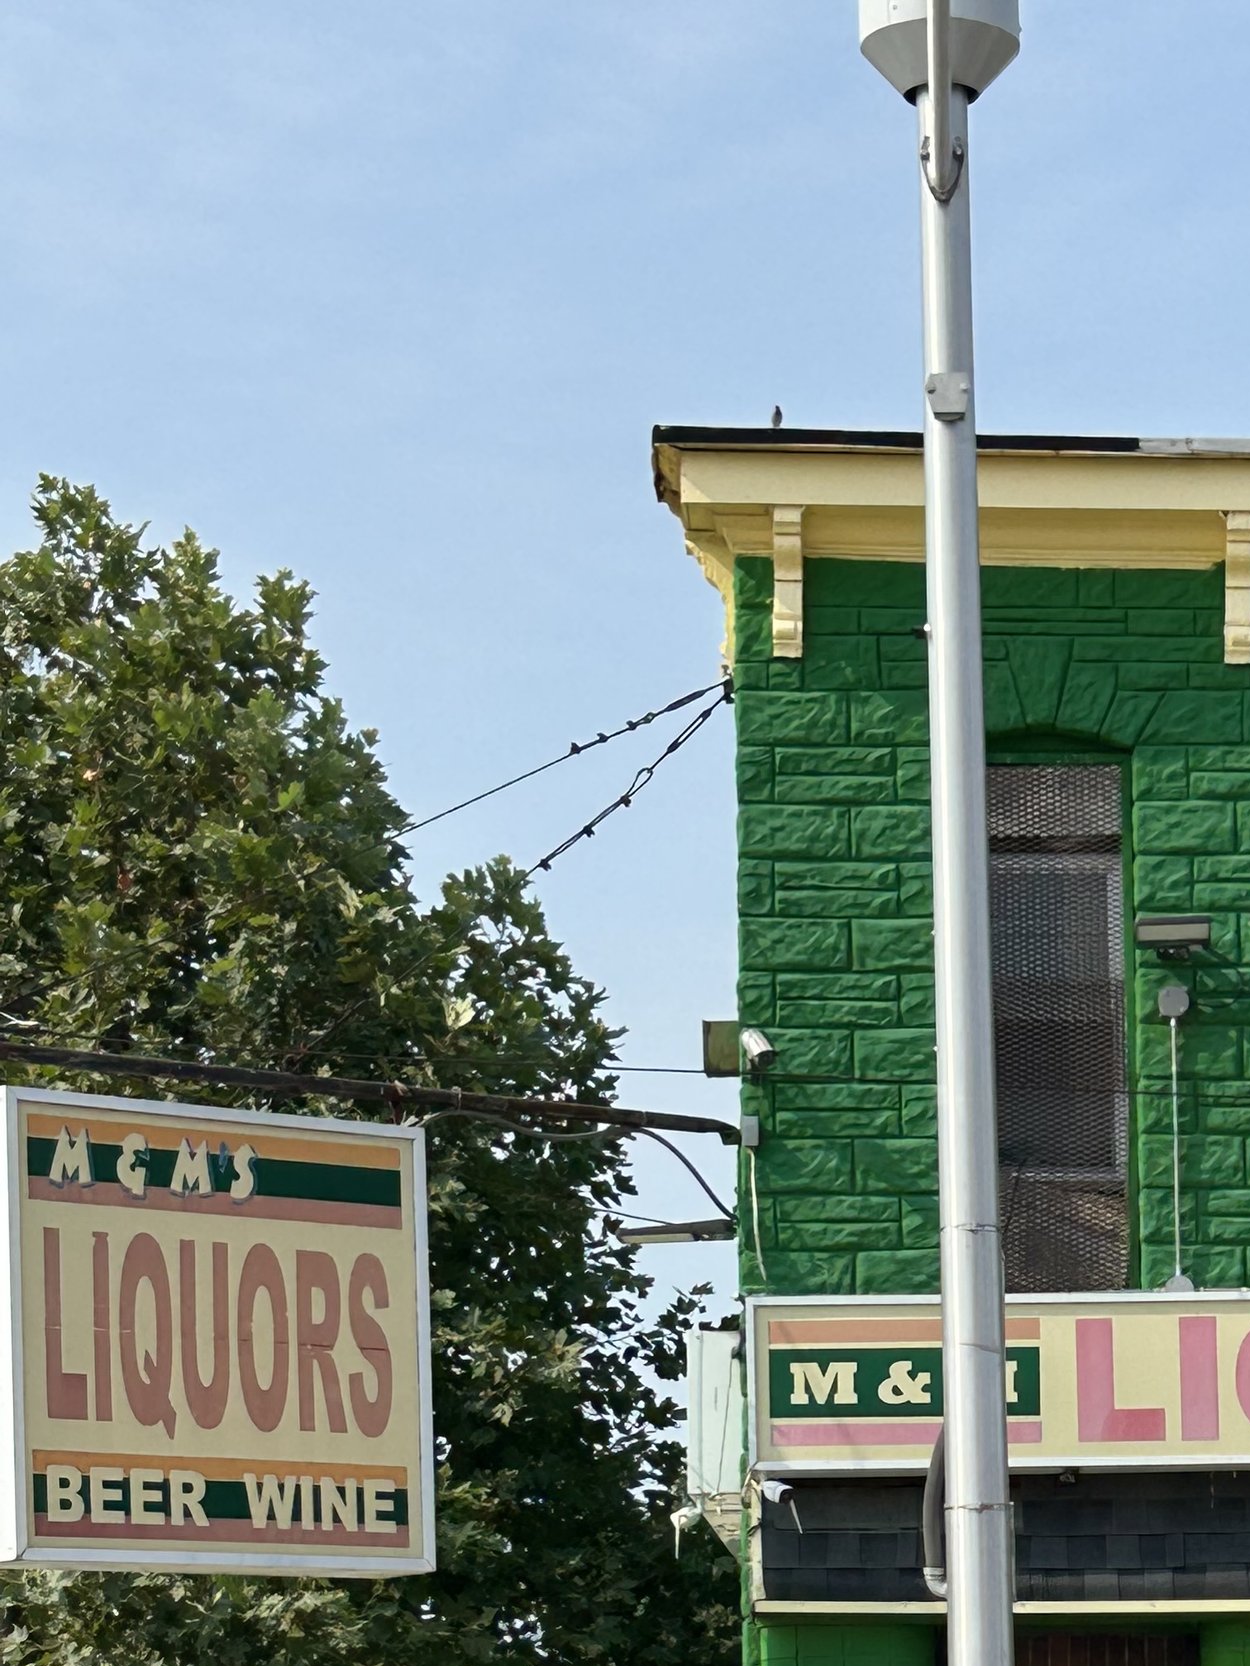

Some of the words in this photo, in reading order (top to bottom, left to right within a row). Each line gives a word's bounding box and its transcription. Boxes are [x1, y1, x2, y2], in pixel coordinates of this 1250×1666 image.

[43, 1226, 393, 1440] LIQUORS
[789, 1361, 858, 1405] M
[877, 1359, 932, 1405] &
[46, 1464, 211, 1527] BEER
[243, 1472, 398, 1534] WINE
